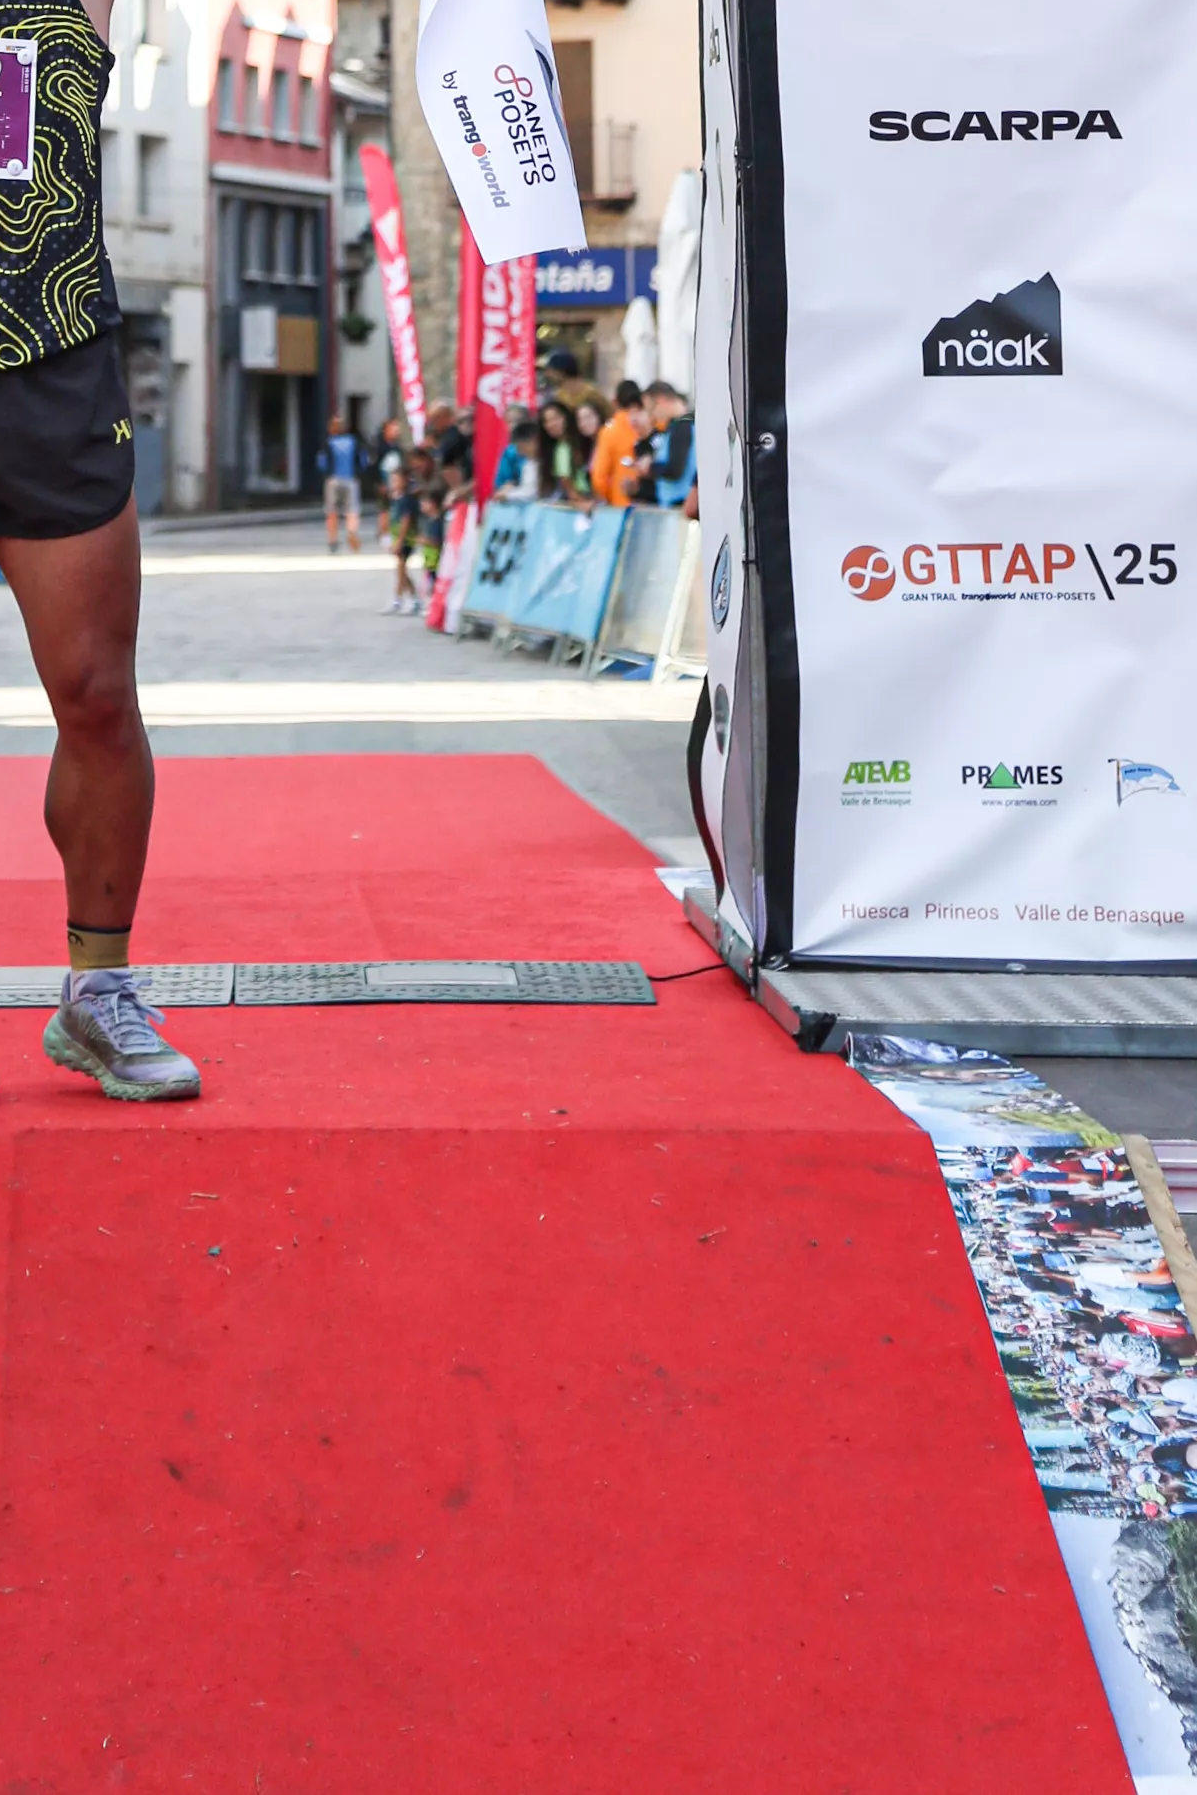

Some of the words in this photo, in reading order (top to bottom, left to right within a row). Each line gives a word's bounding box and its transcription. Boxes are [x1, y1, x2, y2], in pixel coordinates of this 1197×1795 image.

[442, 70, 459, 90] by
[494, 90, 540, 186] POSETS
[869, 110, 1122, 141] SCARPA
[521, 100, 556, 183] ANETO
[938, 329, 1049, 367] näak
[903, 543, 1075, 585] GTTAP
[902, 593, 928, 602] GRAN
[931, 593, 957, 601] TRAIL
[1019, 592, 1096, 601] ANETO-POSETS
[841, 797, 860, 805] Valle
[873, 796, 911, 808] Benasque
[981, 798, 1058, 808] www.prames.com
[842, 903, 909, 920] Huesca
[925, 903, 999, 921] Pirineos
[1015, 904, 1061, 921] Valle
[1067, 905, 1088, 922] de
[1094, 906, 1185, 927] Benasque
